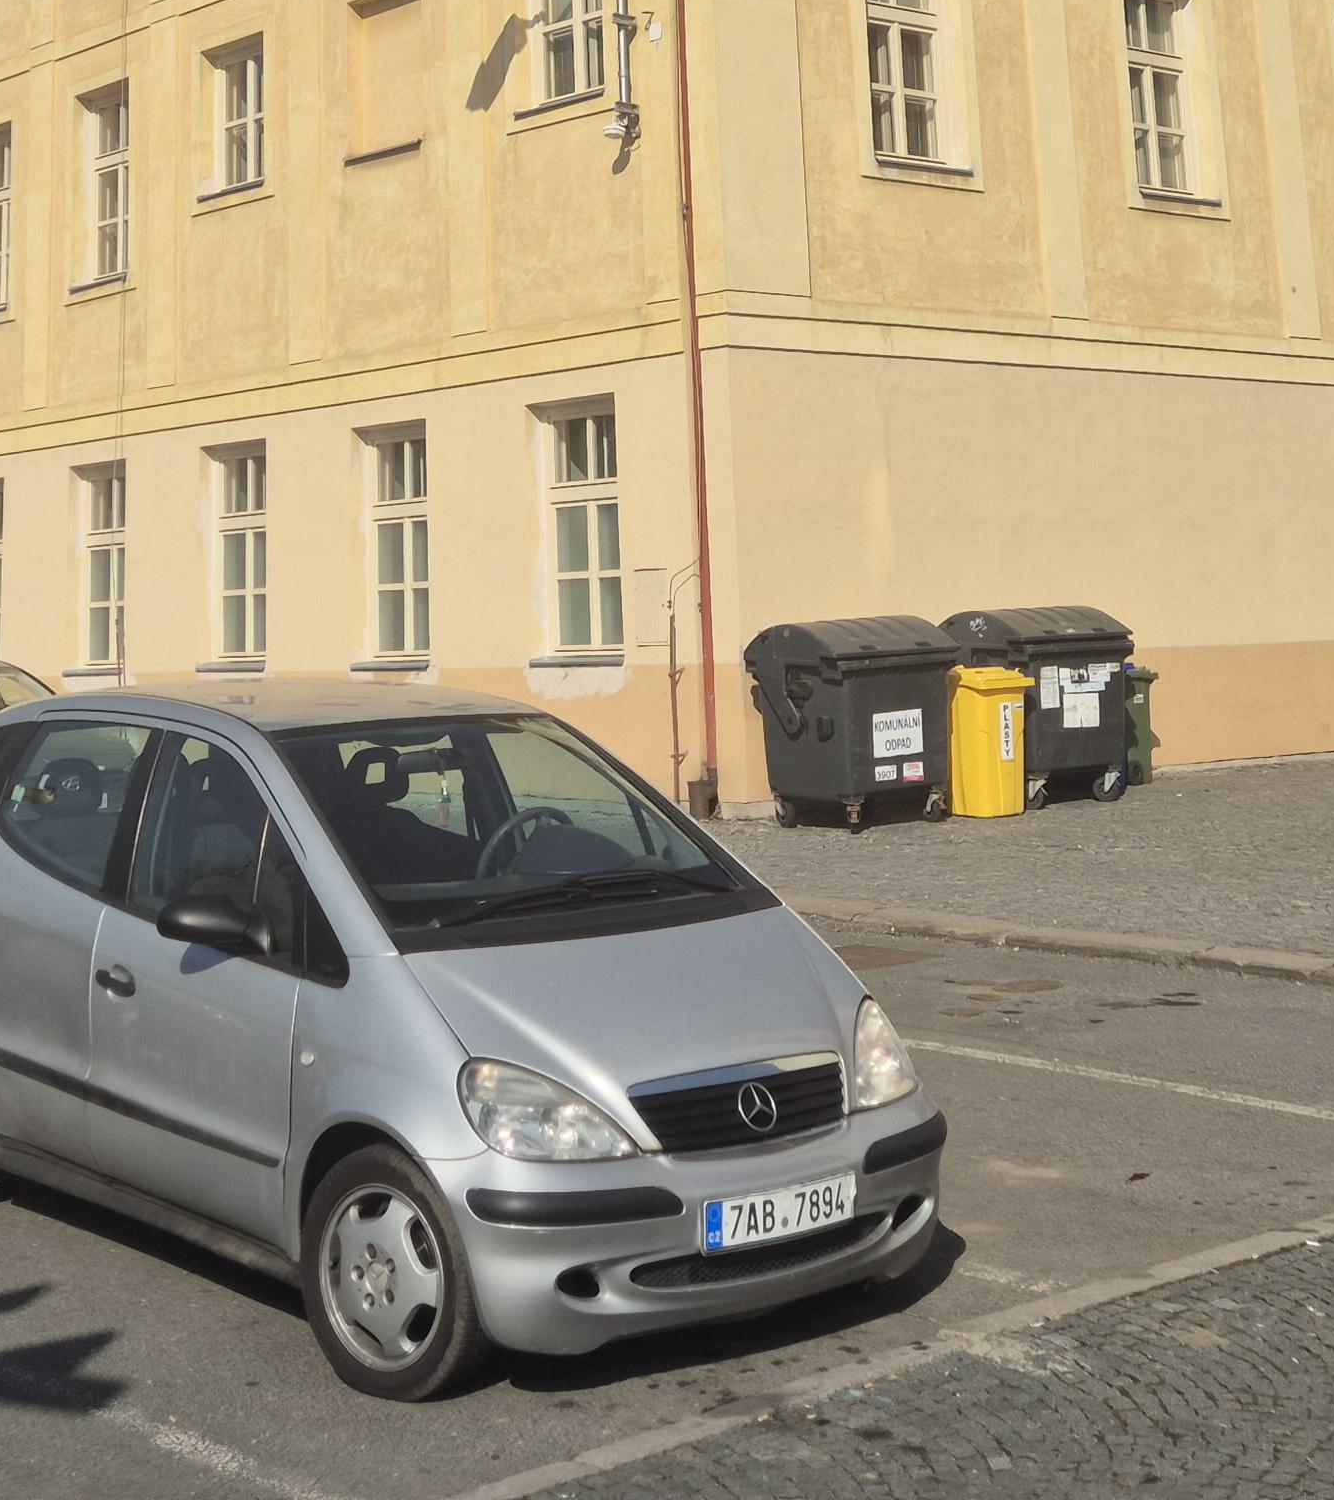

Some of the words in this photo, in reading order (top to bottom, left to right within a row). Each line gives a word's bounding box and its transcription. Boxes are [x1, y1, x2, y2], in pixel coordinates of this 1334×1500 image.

[874, 713, 921, 732] KOMUNÁLNÍ
[1002, 704, 1011, 757] PLASTY
[885, 737, 912, 751] ODPAD
[876, 770, 895, 780] 3907
[730, 1199, 776, 1240] 7AB
[794, 1182, 845, 1228] 7894
[708, 1232, 720, 1243] CZ
